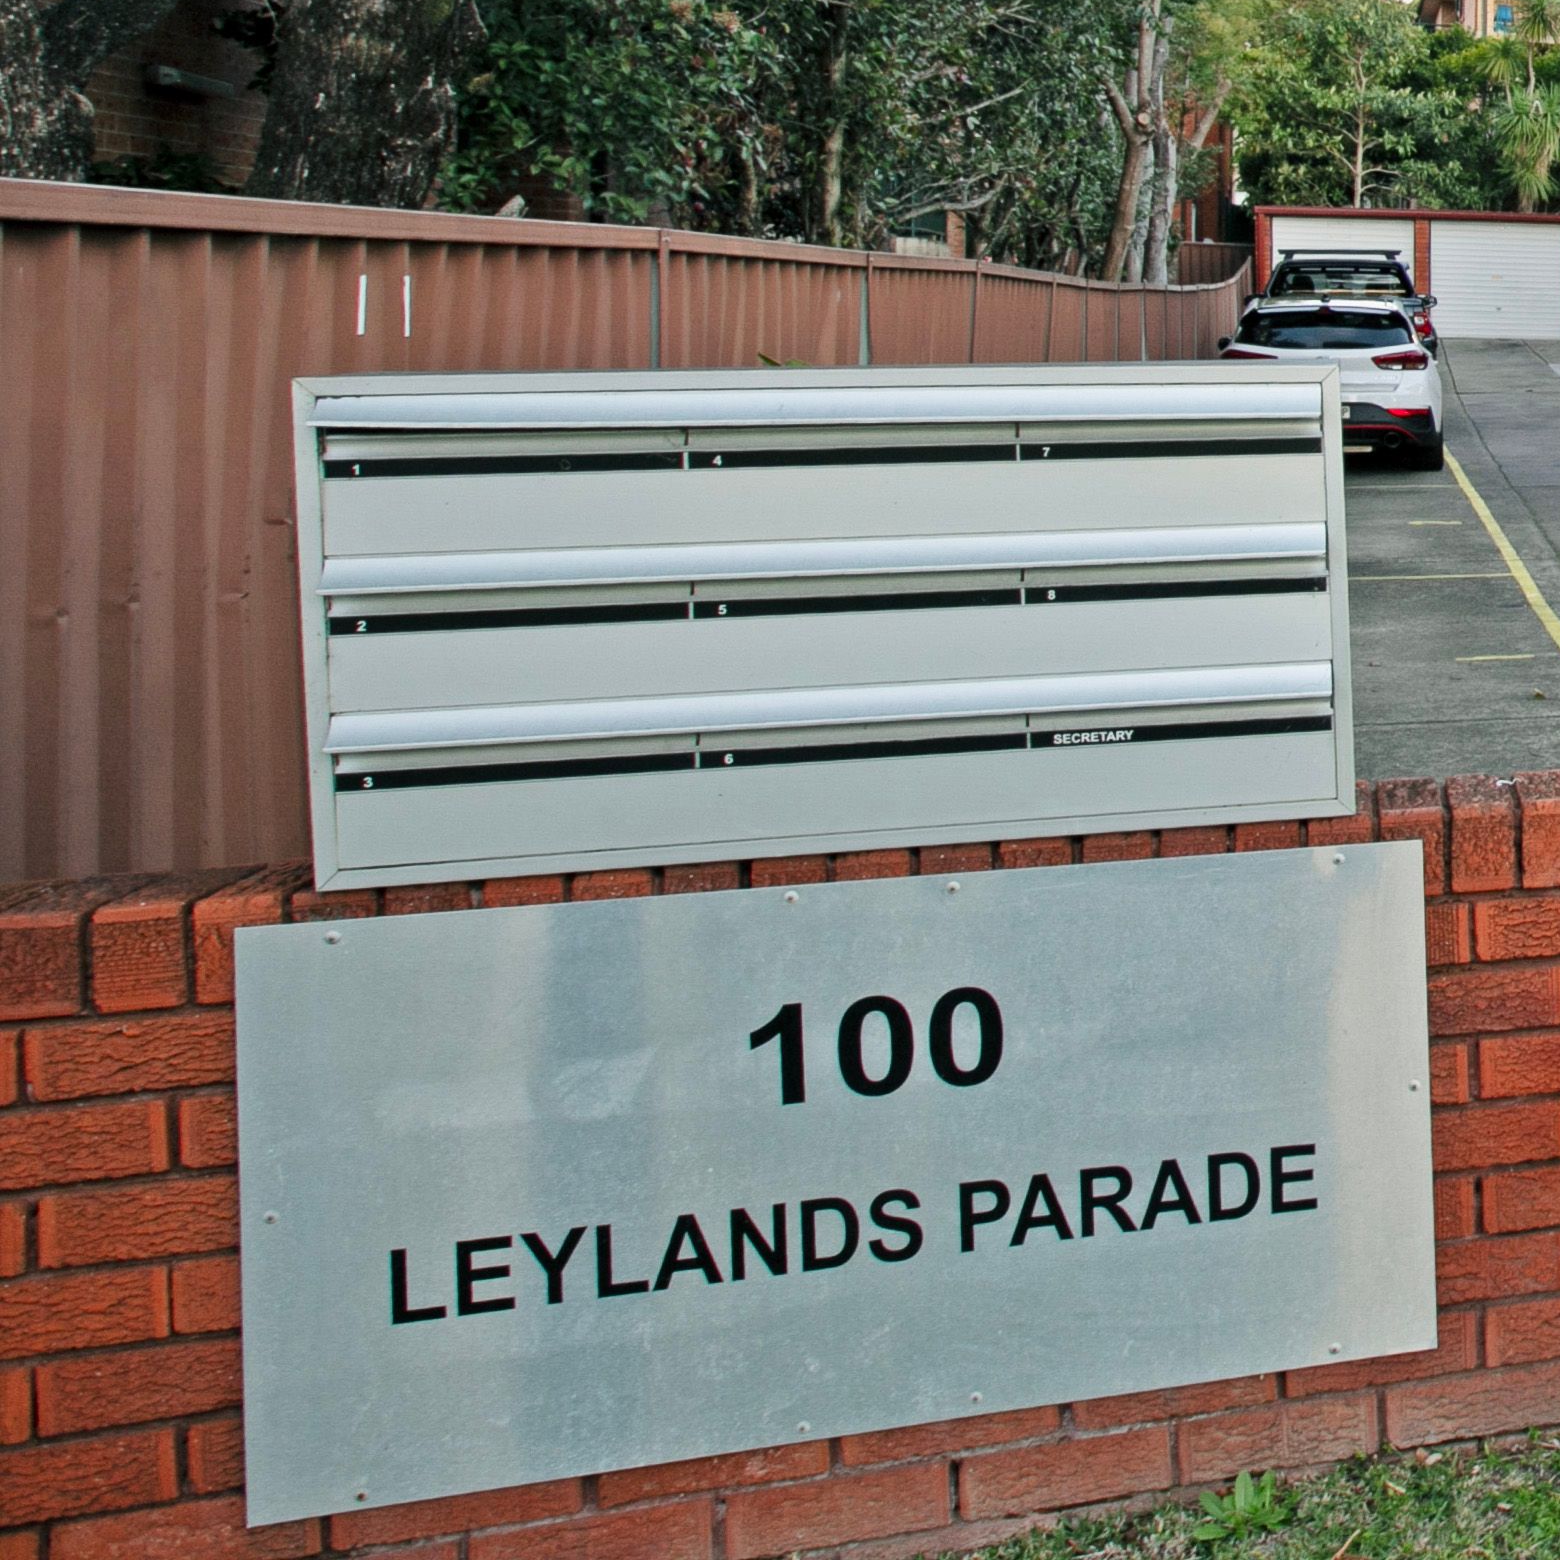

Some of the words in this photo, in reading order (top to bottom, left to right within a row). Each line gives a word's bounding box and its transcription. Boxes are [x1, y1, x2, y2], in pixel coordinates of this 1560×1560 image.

[1042, 446, 1050, 457] 7
[713, 455, 722, 466] 4
[352, 464, 360, 475] 1
[1047, 589, 1056, 601] 8
[718, 604, 727, 615] 5
[357, 620, 367, 632] 2
[1053, 729, 1134, 745] SECRETARY
[724, 753, 734, 765] 6
[363, 776, 373, 788] 3
[748, 986, 1004, 1106] 100
[389, 1188, 924, 1326] LEYLANDS
[957, 1143, 1318, 1253] PARADE
